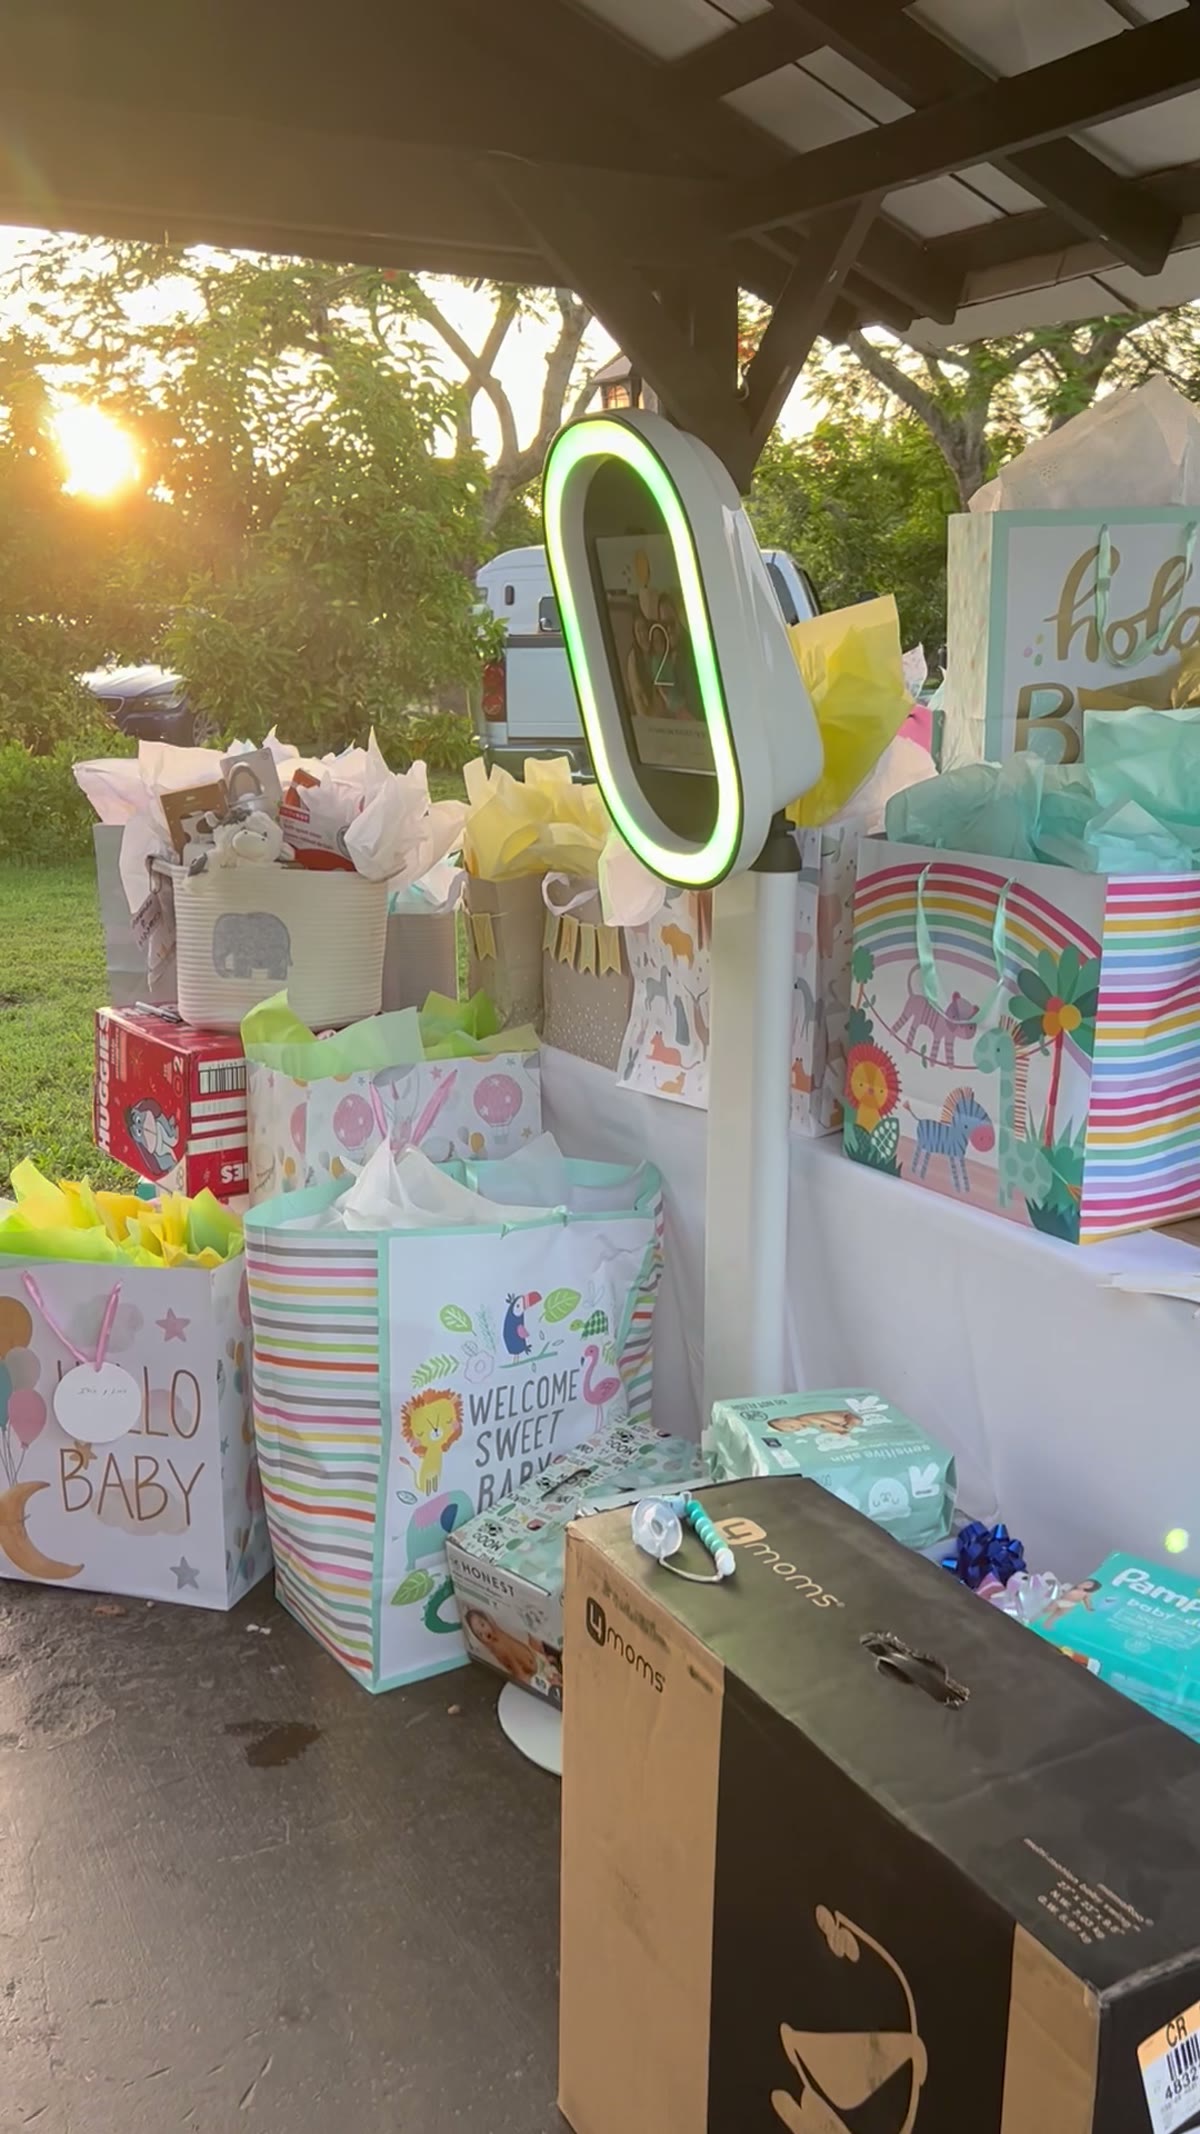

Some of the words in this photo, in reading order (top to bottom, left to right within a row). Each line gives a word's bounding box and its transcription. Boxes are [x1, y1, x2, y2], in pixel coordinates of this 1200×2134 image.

[649, 623, 675, 686] 2
[98, 1013, 112, 1154] HUGGIES
[173, 1056, 184, 1075] 2
[468, 1368, 578, 1427] WELCOME
[475, 1409, 564, 1467] SWEET
[59, 1448, 205, 1526] BABY
[461, 1560, 515, 1597] HONEST
[1166, 2016, 1187, 2048] CR
[1165, 2064, 1200, 2100] 4832
